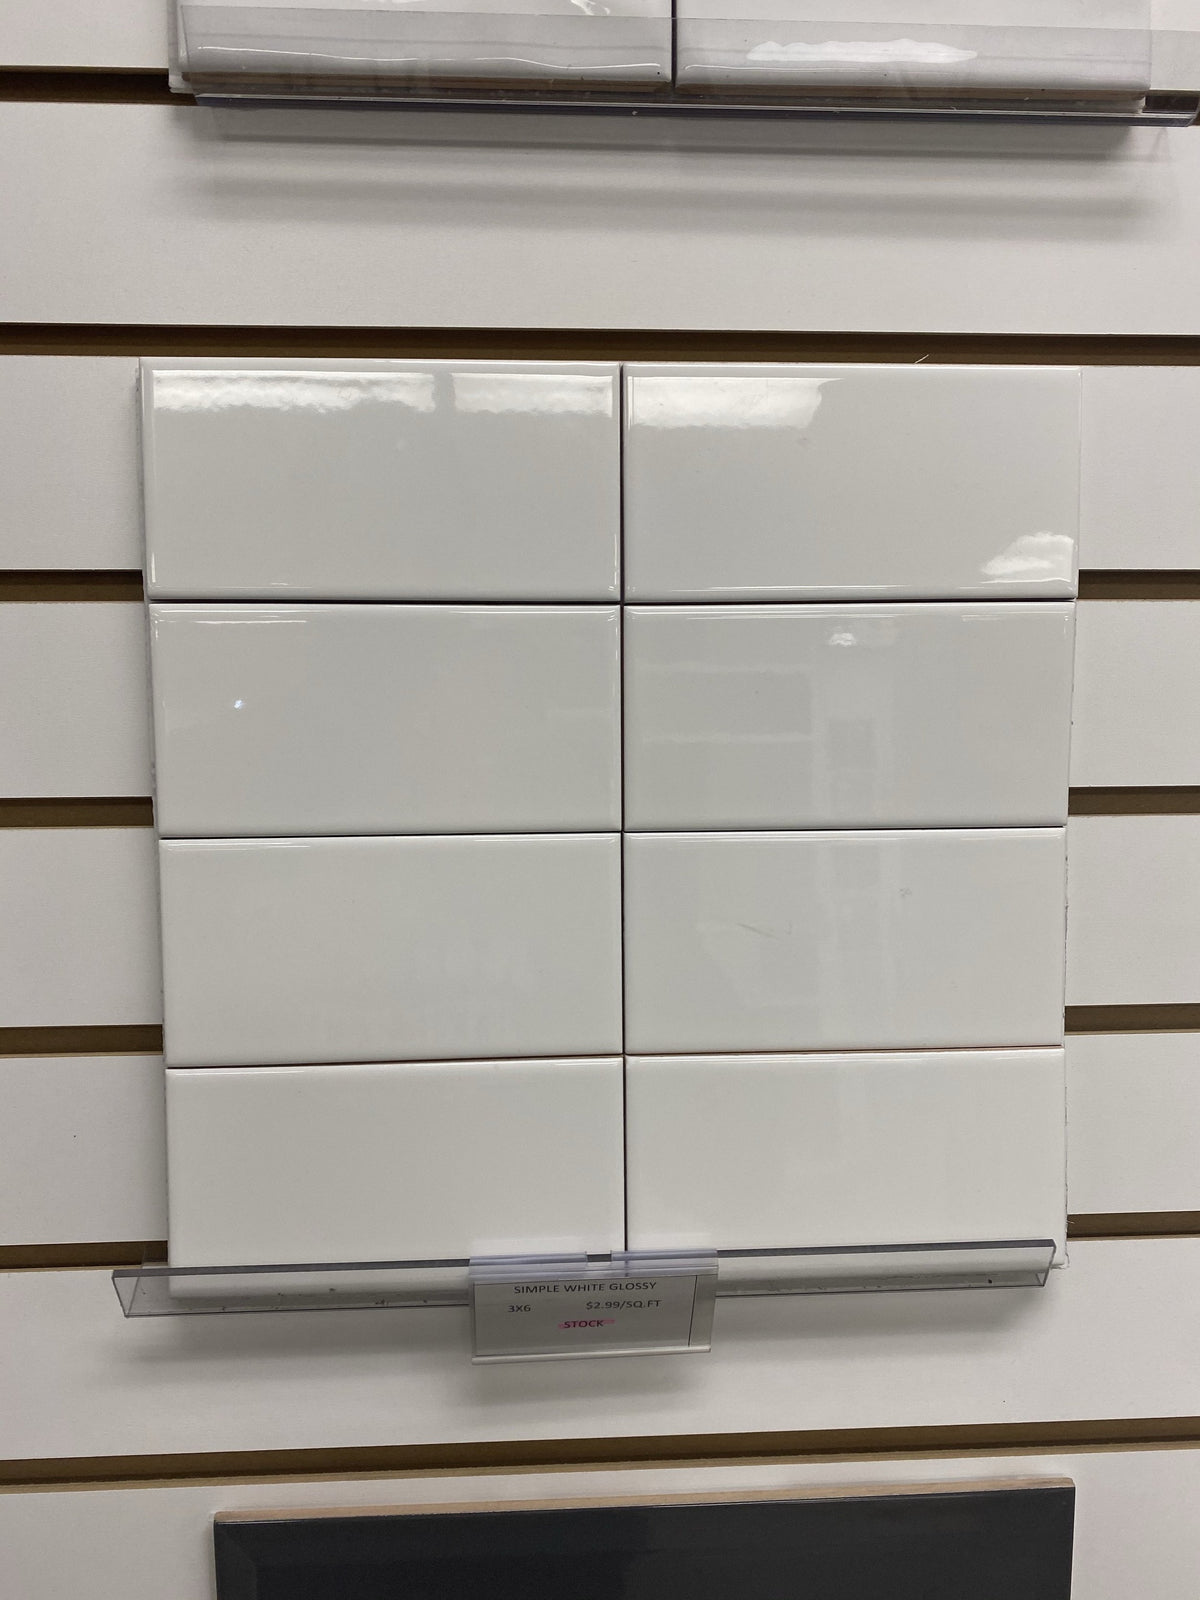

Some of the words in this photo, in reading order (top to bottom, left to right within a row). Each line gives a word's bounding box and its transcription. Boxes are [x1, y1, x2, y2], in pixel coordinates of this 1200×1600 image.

[514, 1284, 560, 1293] SIMPLE
[564, 1283, 605, 1292] WHITE
[609, 1281, 657, 1291] GLOSSY
[508, 1304, 531, 1313] 3X6
[586, 1299, 662, 1310] $2.99/SQ.FT
[564, 1319, 605, 1329] STOCK
